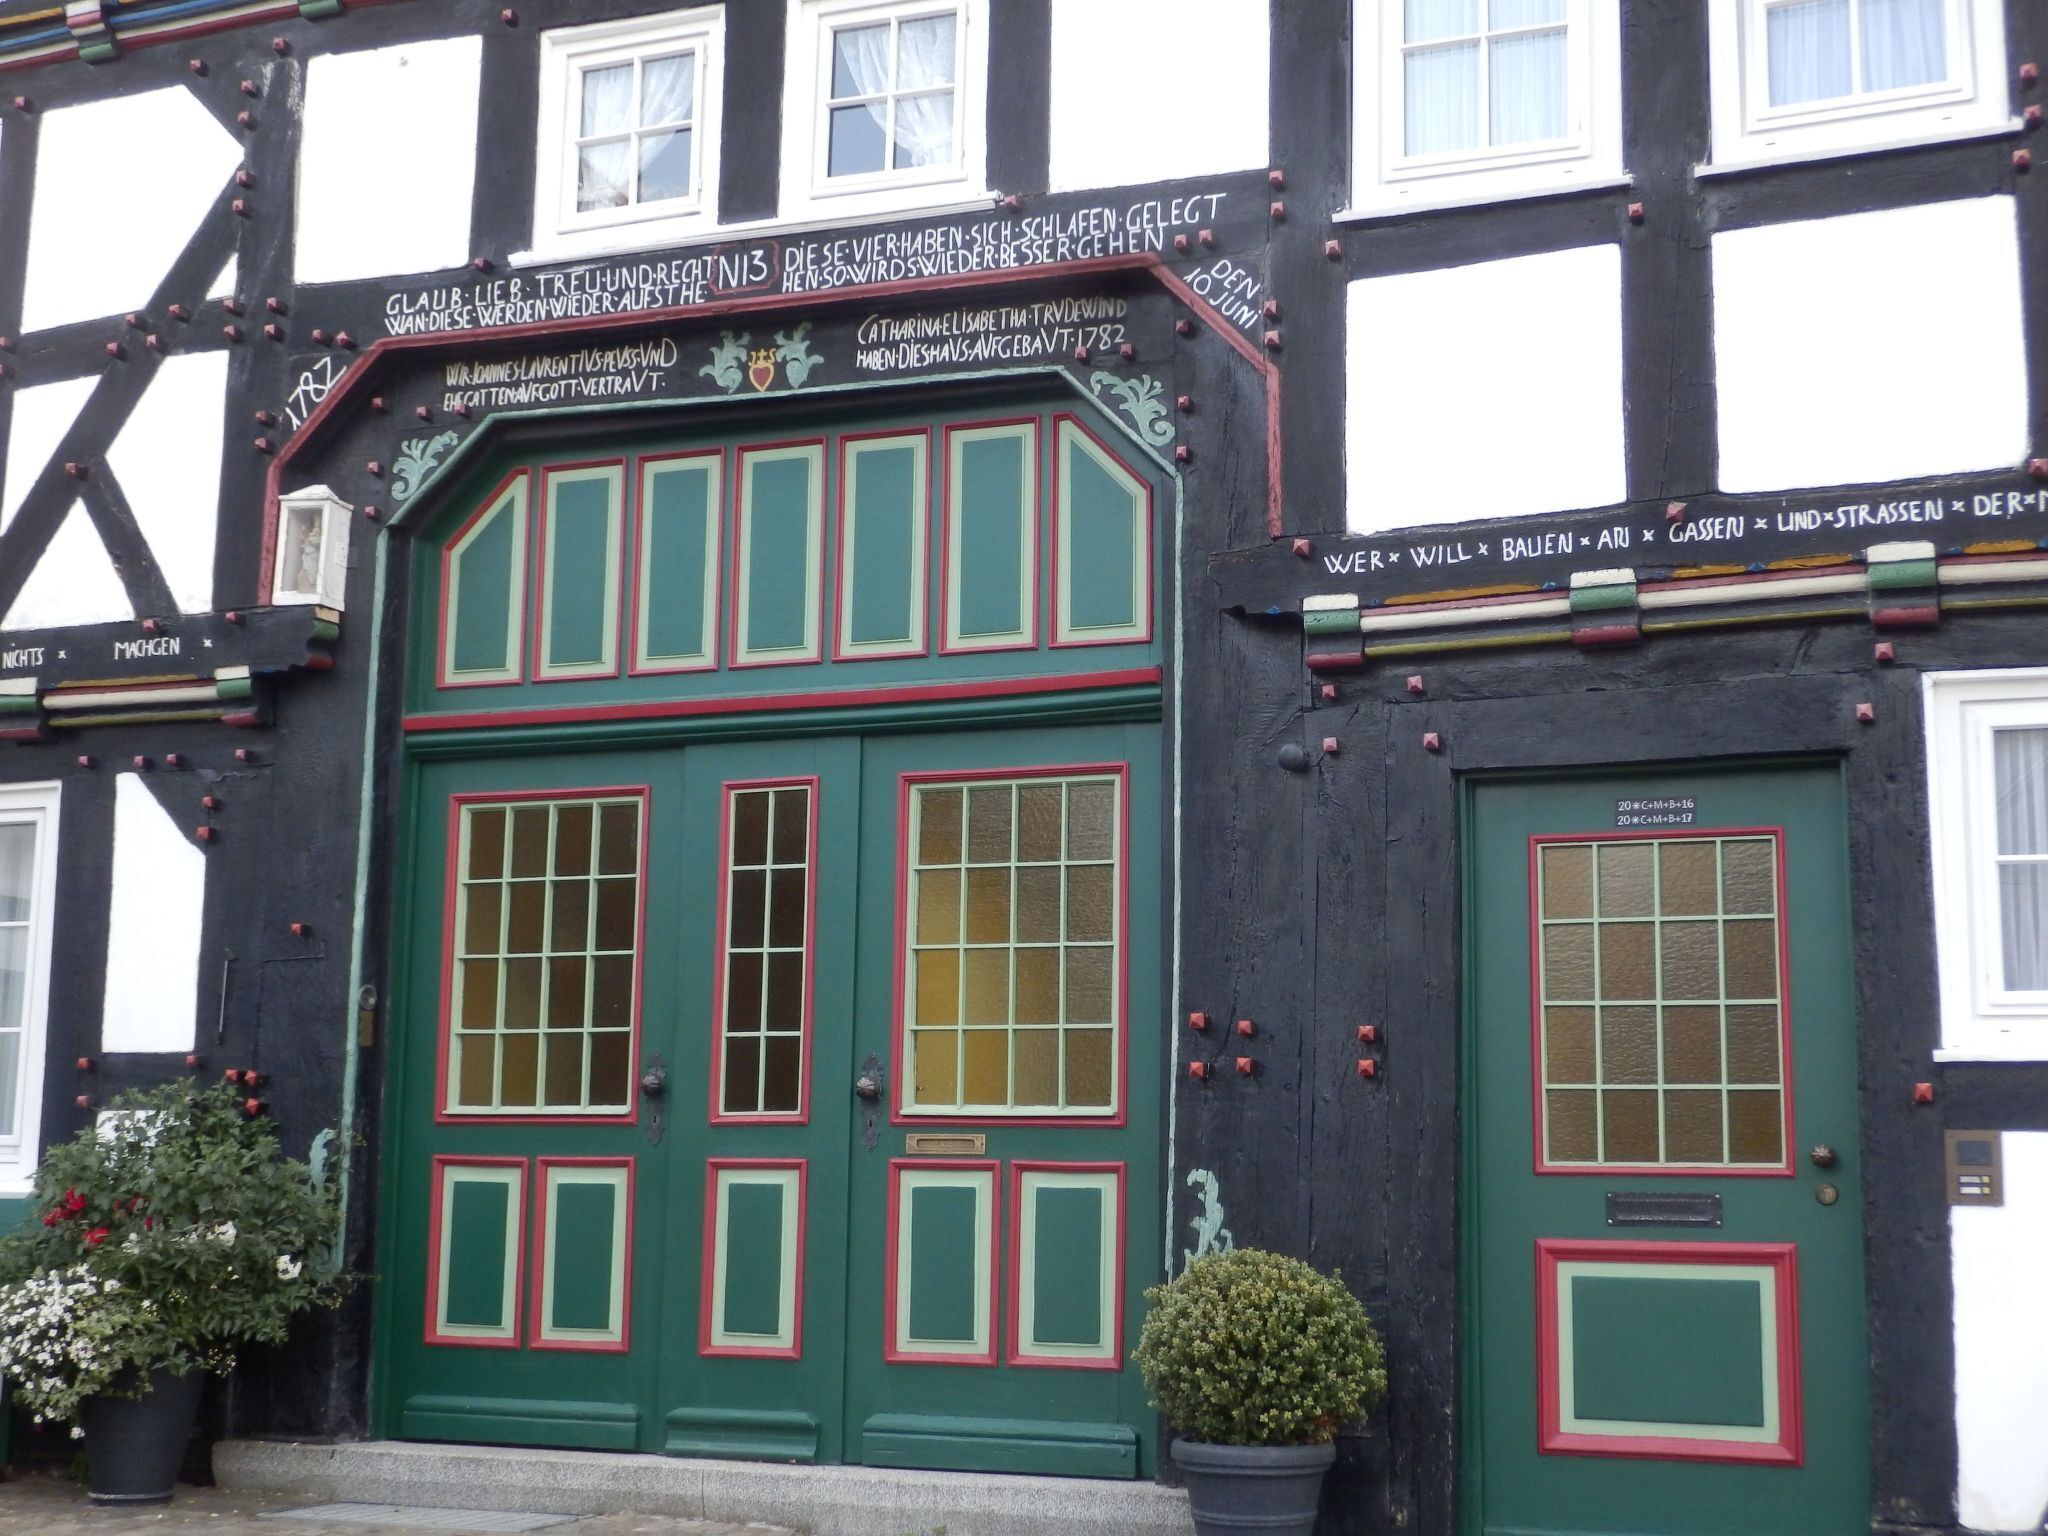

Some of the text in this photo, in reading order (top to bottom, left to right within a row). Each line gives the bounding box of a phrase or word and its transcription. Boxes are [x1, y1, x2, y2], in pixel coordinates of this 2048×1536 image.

[785, 192, 1227, 272] DIESE VIER HABEN SICH SCHLAFEN GELEGT
[782, 268, 819, 293] HEN
[820, 265, 846, 289] SO
[918, 244, 995, 277] WIEDER
[999, 237, 1072, 268] BESSER
[1077, 226, 1164, 259] GEHEN
[1183, 267, 1212, 295] 10
[1211, 259, 1261, 300] DEN
[387, 255, 717, 315] GLAUB LIEB TREU UND RECHT
[384, 312, 427, 336] WAN
[429, 305, 473, 332] DIESE
[476, 298, 547, 327] WERDEN
[549, 292, 615, 319] WIEDER
[857, 313, 940, 344] CATHARINA
[943, 307, 1027, 336] ELISABETHA
[446, 362, 470, 386] WIR
[640, 337, 677, 368] VND
[856, 347, 896, 371] HABEN
[898, 339, 930, 369] DIES
[930, 337, 970, 363] HAVS
[1078, 324, 1125, 351] 1782
[284, 356, 348, 431] 1782
[539, 379, 579, 402] GOTT
[1324, 551, 1384, 575] WER
[1410, 543, 1472, 568] WILL
[1503, 532, 1573, 562] BAUEN
[1597, 526, 1629, 550] AN
[1669, 516, 1744, 543] GASSEN
[1777, 510, 1822, 532] UND
[1833, 498, 1944, 529] STRASSEN
[1973, 491, 2024, 516] DER
[2, 647, 45, 669] NICHTS
